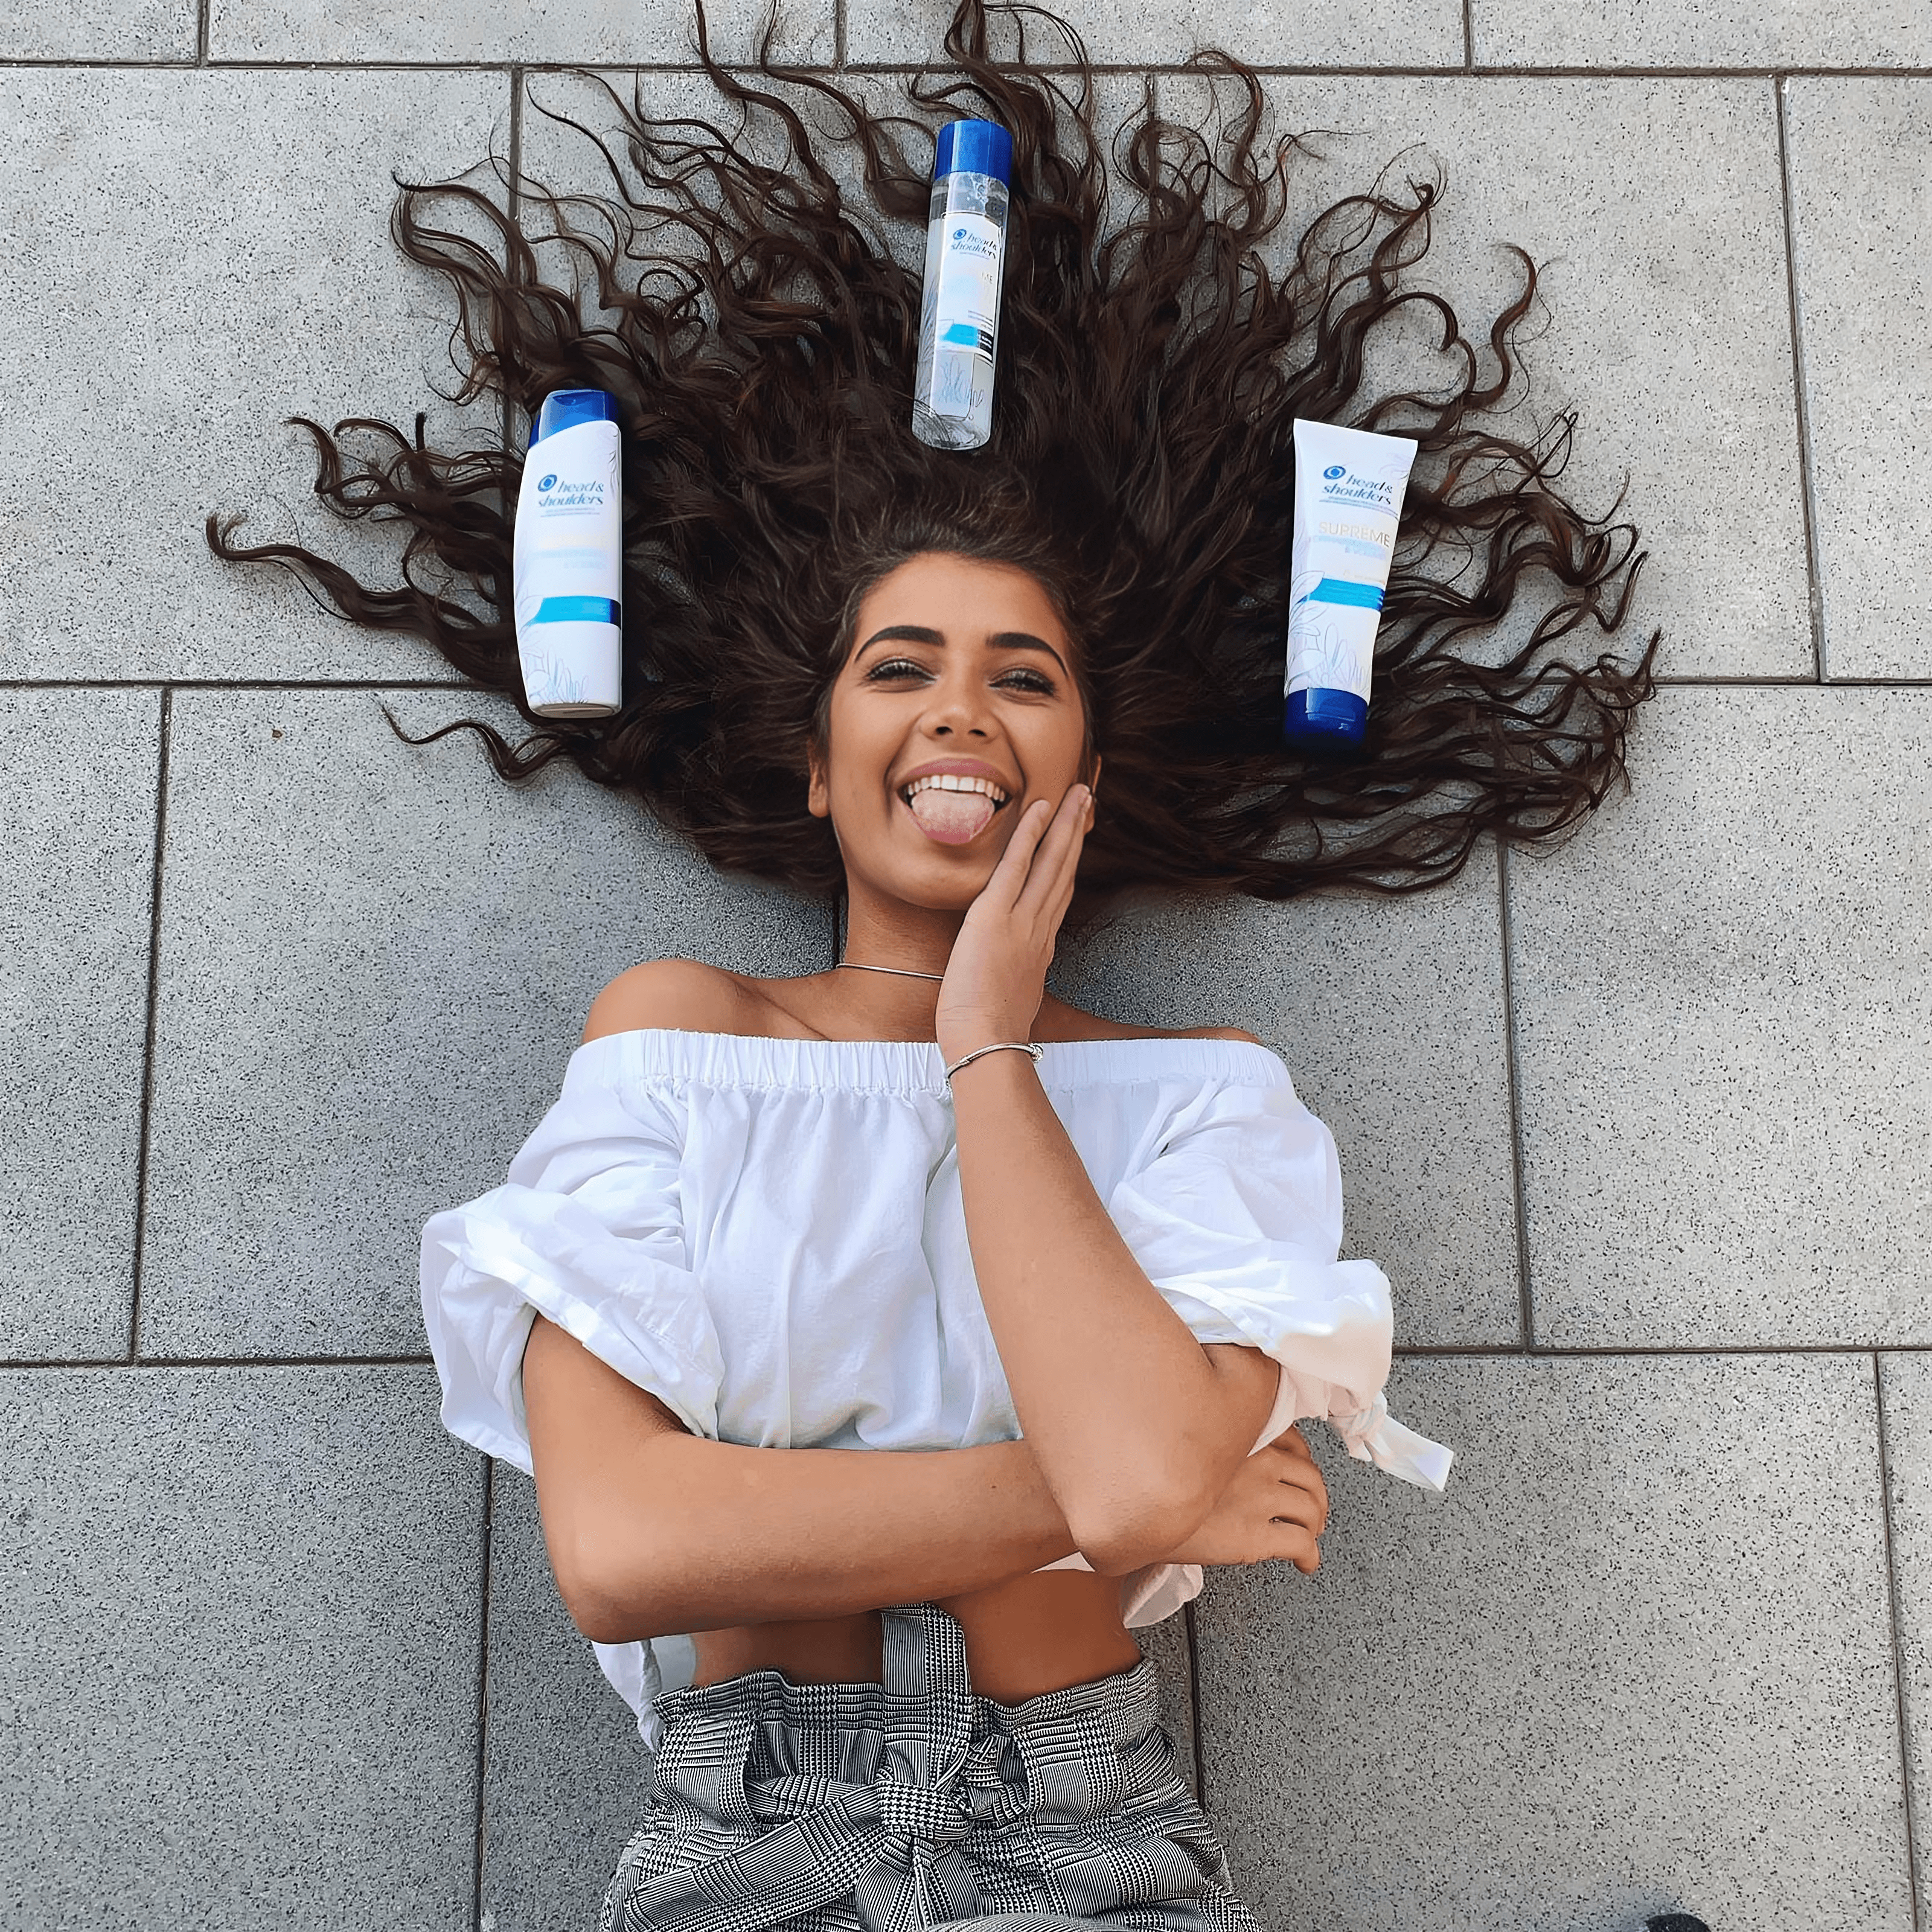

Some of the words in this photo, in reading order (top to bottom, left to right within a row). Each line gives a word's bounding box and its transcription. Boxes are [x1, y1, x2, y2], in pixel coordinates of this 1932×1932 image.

[951, 241, 996, 259] shoulders
[539, 493, 603, 507] shoulders
[1322, 484, 1391, 505] shoulders
